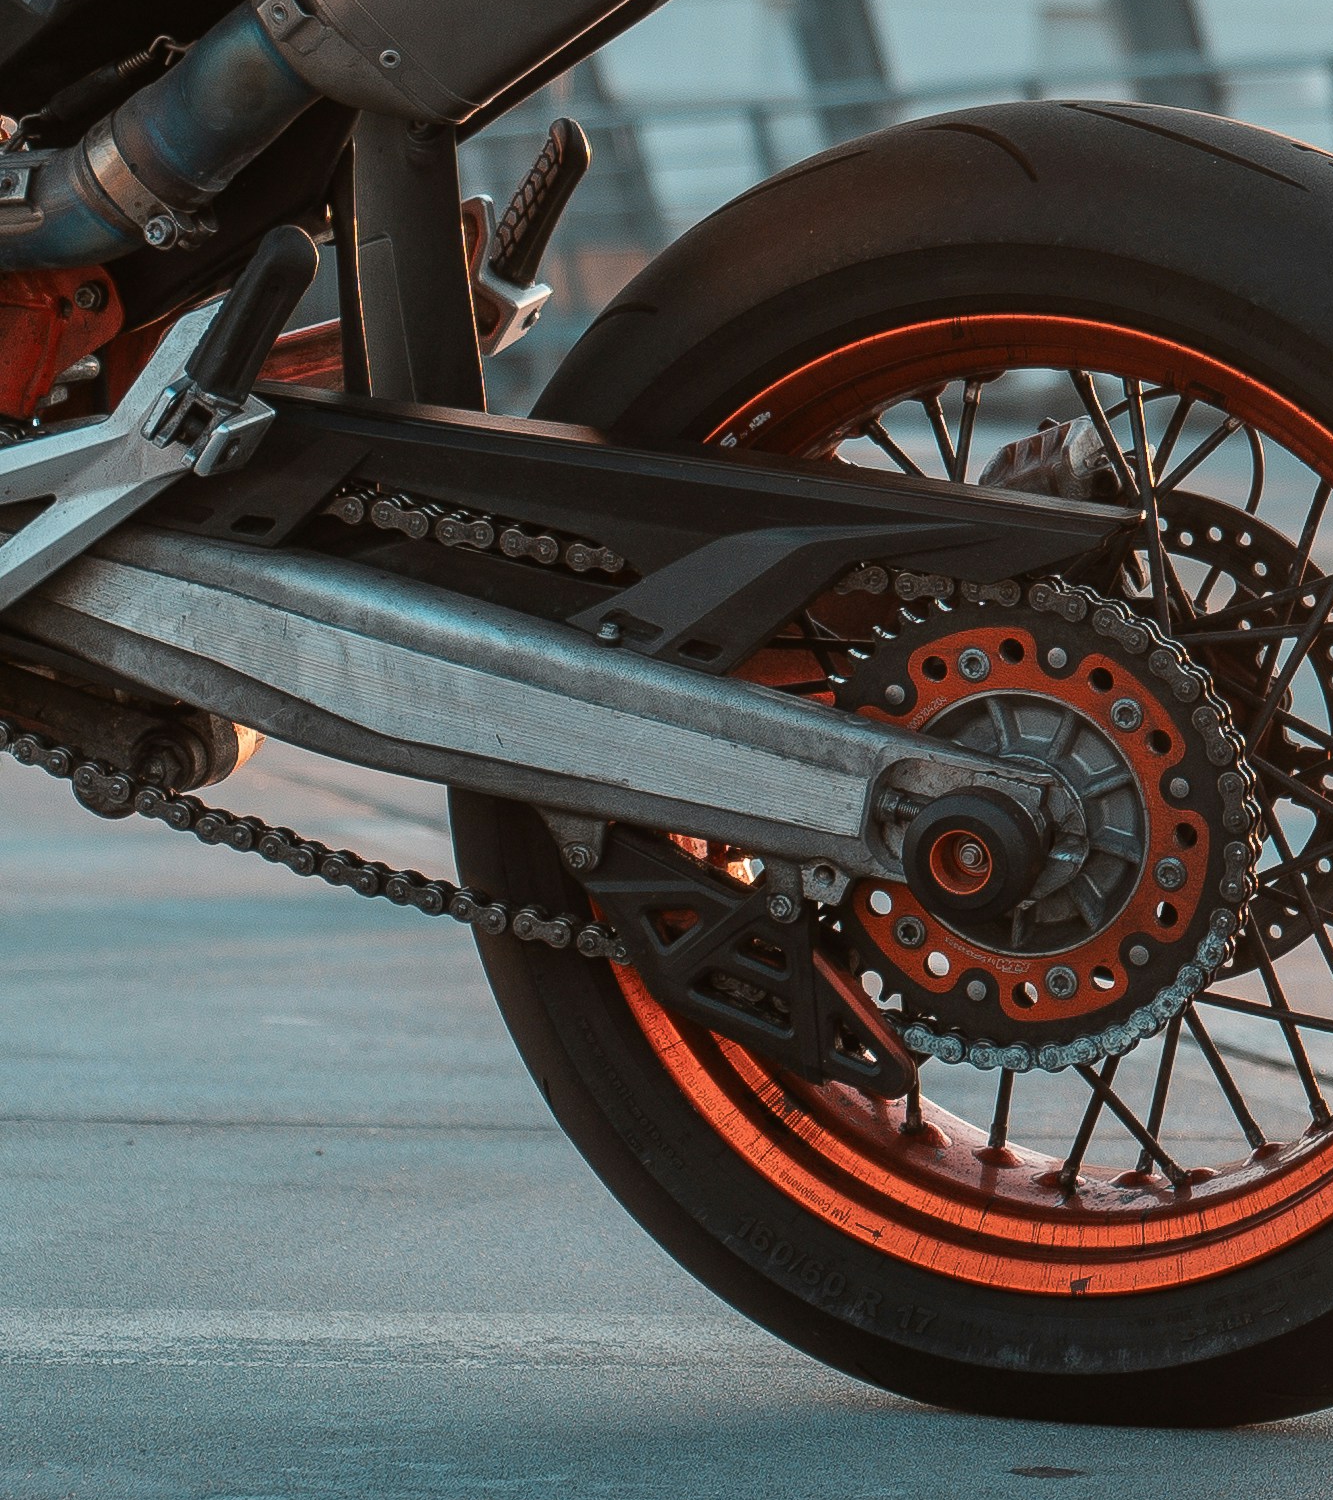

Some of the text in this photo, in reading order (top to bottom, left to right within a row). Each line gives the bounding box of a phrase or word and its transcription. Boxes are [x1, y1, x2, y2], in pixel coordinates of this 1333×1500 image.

[734, 1215, 940, 1335] 160/60 R 17
